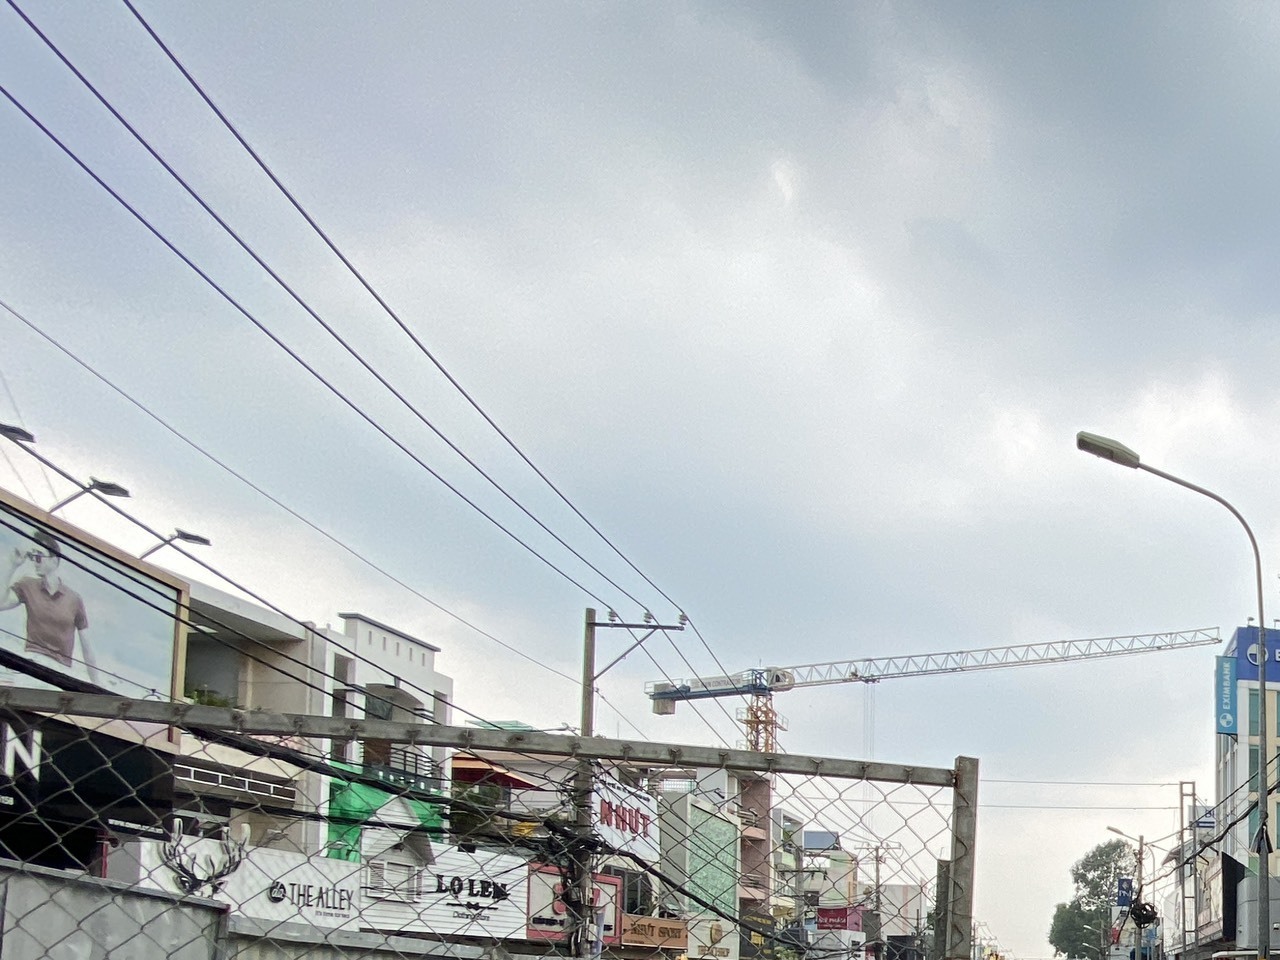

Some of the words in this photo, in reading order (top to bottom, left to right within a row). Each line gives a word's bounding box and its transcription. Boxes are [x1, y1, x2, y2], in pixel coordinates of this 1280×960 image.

[1223, 661, 1232, 710] EXIMBANK
[289, 882, 314, 908] THE
[316, 885, 354, 911] ALLEY
